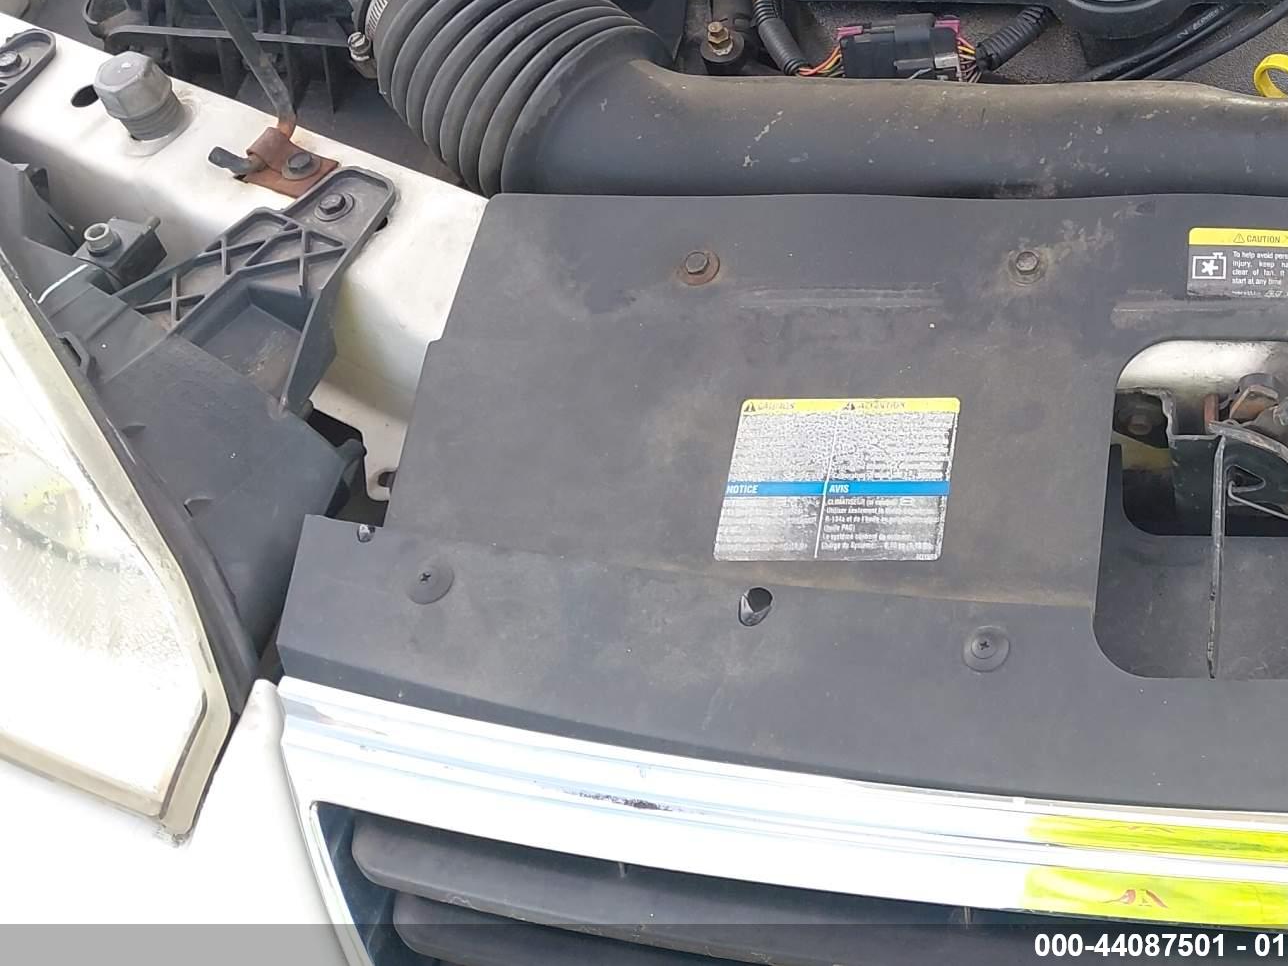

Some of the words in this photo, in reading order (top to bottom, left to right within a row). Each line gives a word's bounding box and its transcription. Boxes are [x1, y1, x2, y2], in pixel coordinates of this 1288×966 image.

[1246, 234, 1281, 244] CAUTION
[1241, 251, 1255, 259] help
[1252, 268, 1259, 276] of
[725, 484, 759, 493] NOTICE
[829, 484, 849, 493] AVIS
